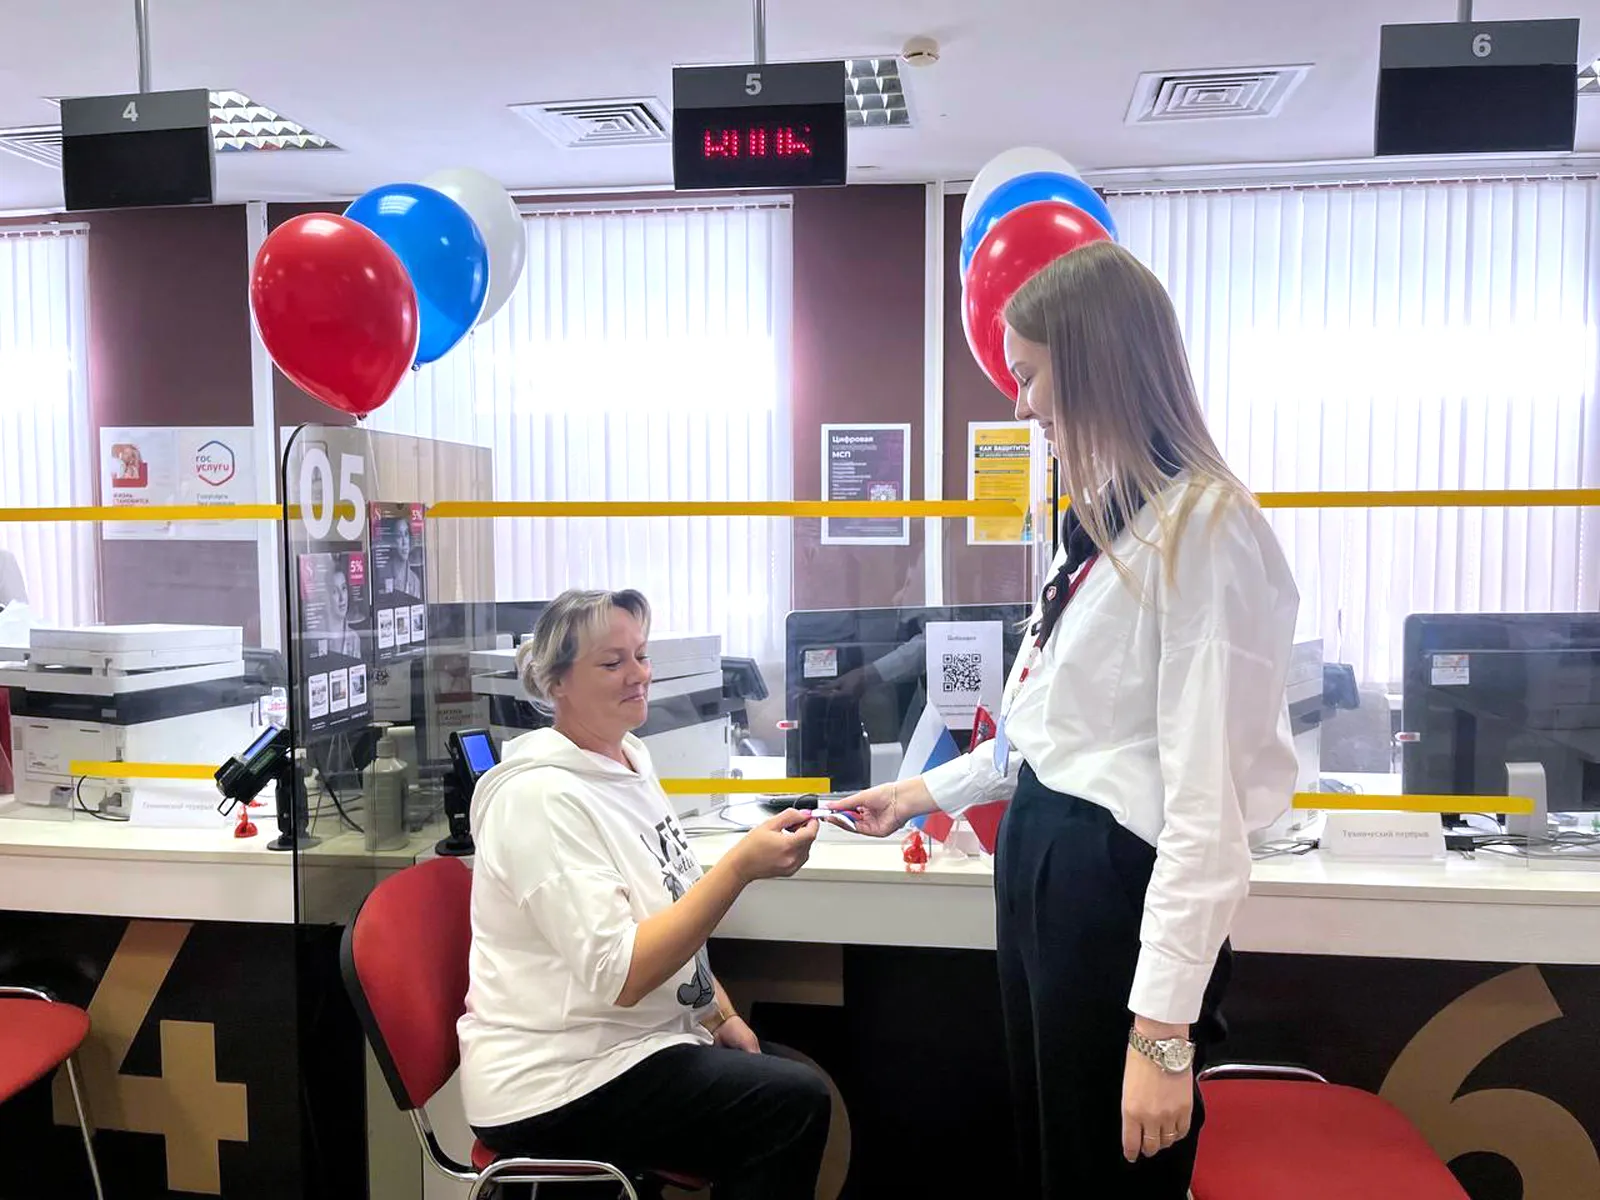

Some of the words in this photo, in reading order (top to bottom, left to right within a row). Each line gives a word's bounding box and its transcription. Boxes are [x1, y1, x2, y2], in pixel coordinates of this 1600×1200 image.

[1472, 33, 1491, 58] 6
[745, 73, 762, 95] 5
[122, 101, 138, 122] 4
[832, 436, 874, 444] Цифровая
[832, 451, 852, 459] МСП
[196, 463, 229, 473] услуги
[300, 448, 366, 541] 05
[350, 560, 363, 572] 5%
[52, 920, 249, 1194] 4
